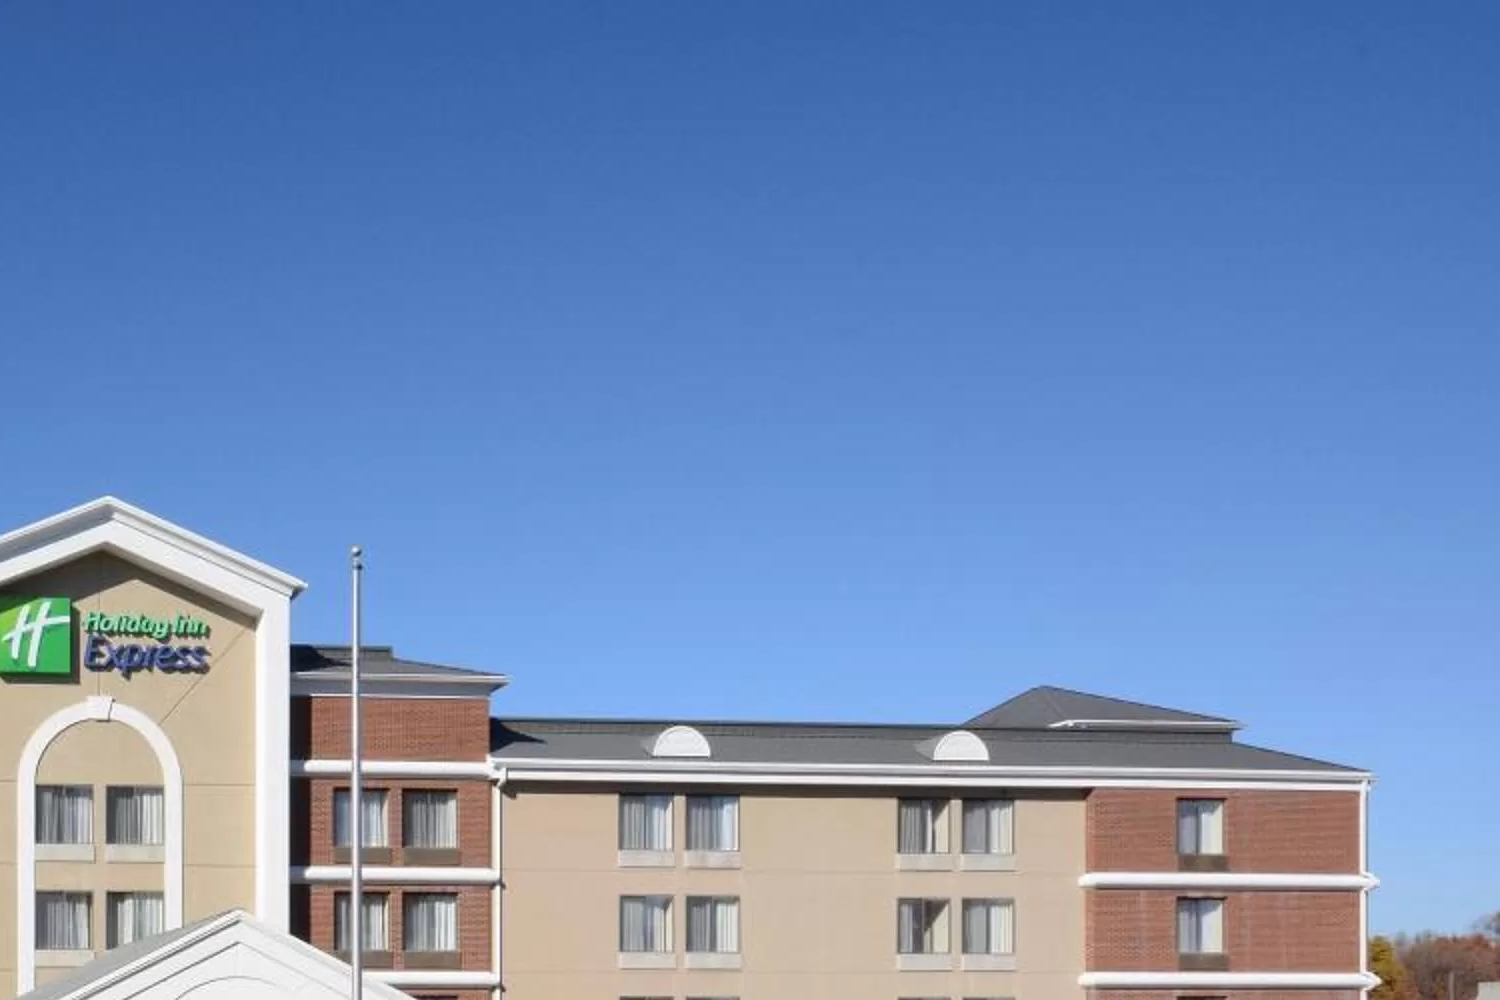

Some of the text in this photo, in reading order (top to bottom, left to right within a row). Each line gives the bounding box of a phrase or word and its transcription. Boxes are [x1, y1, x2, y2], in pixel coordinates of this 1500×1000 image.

[83, 611, 208, 640] Holiday Inn
[83, 633, 209, 679] Express
